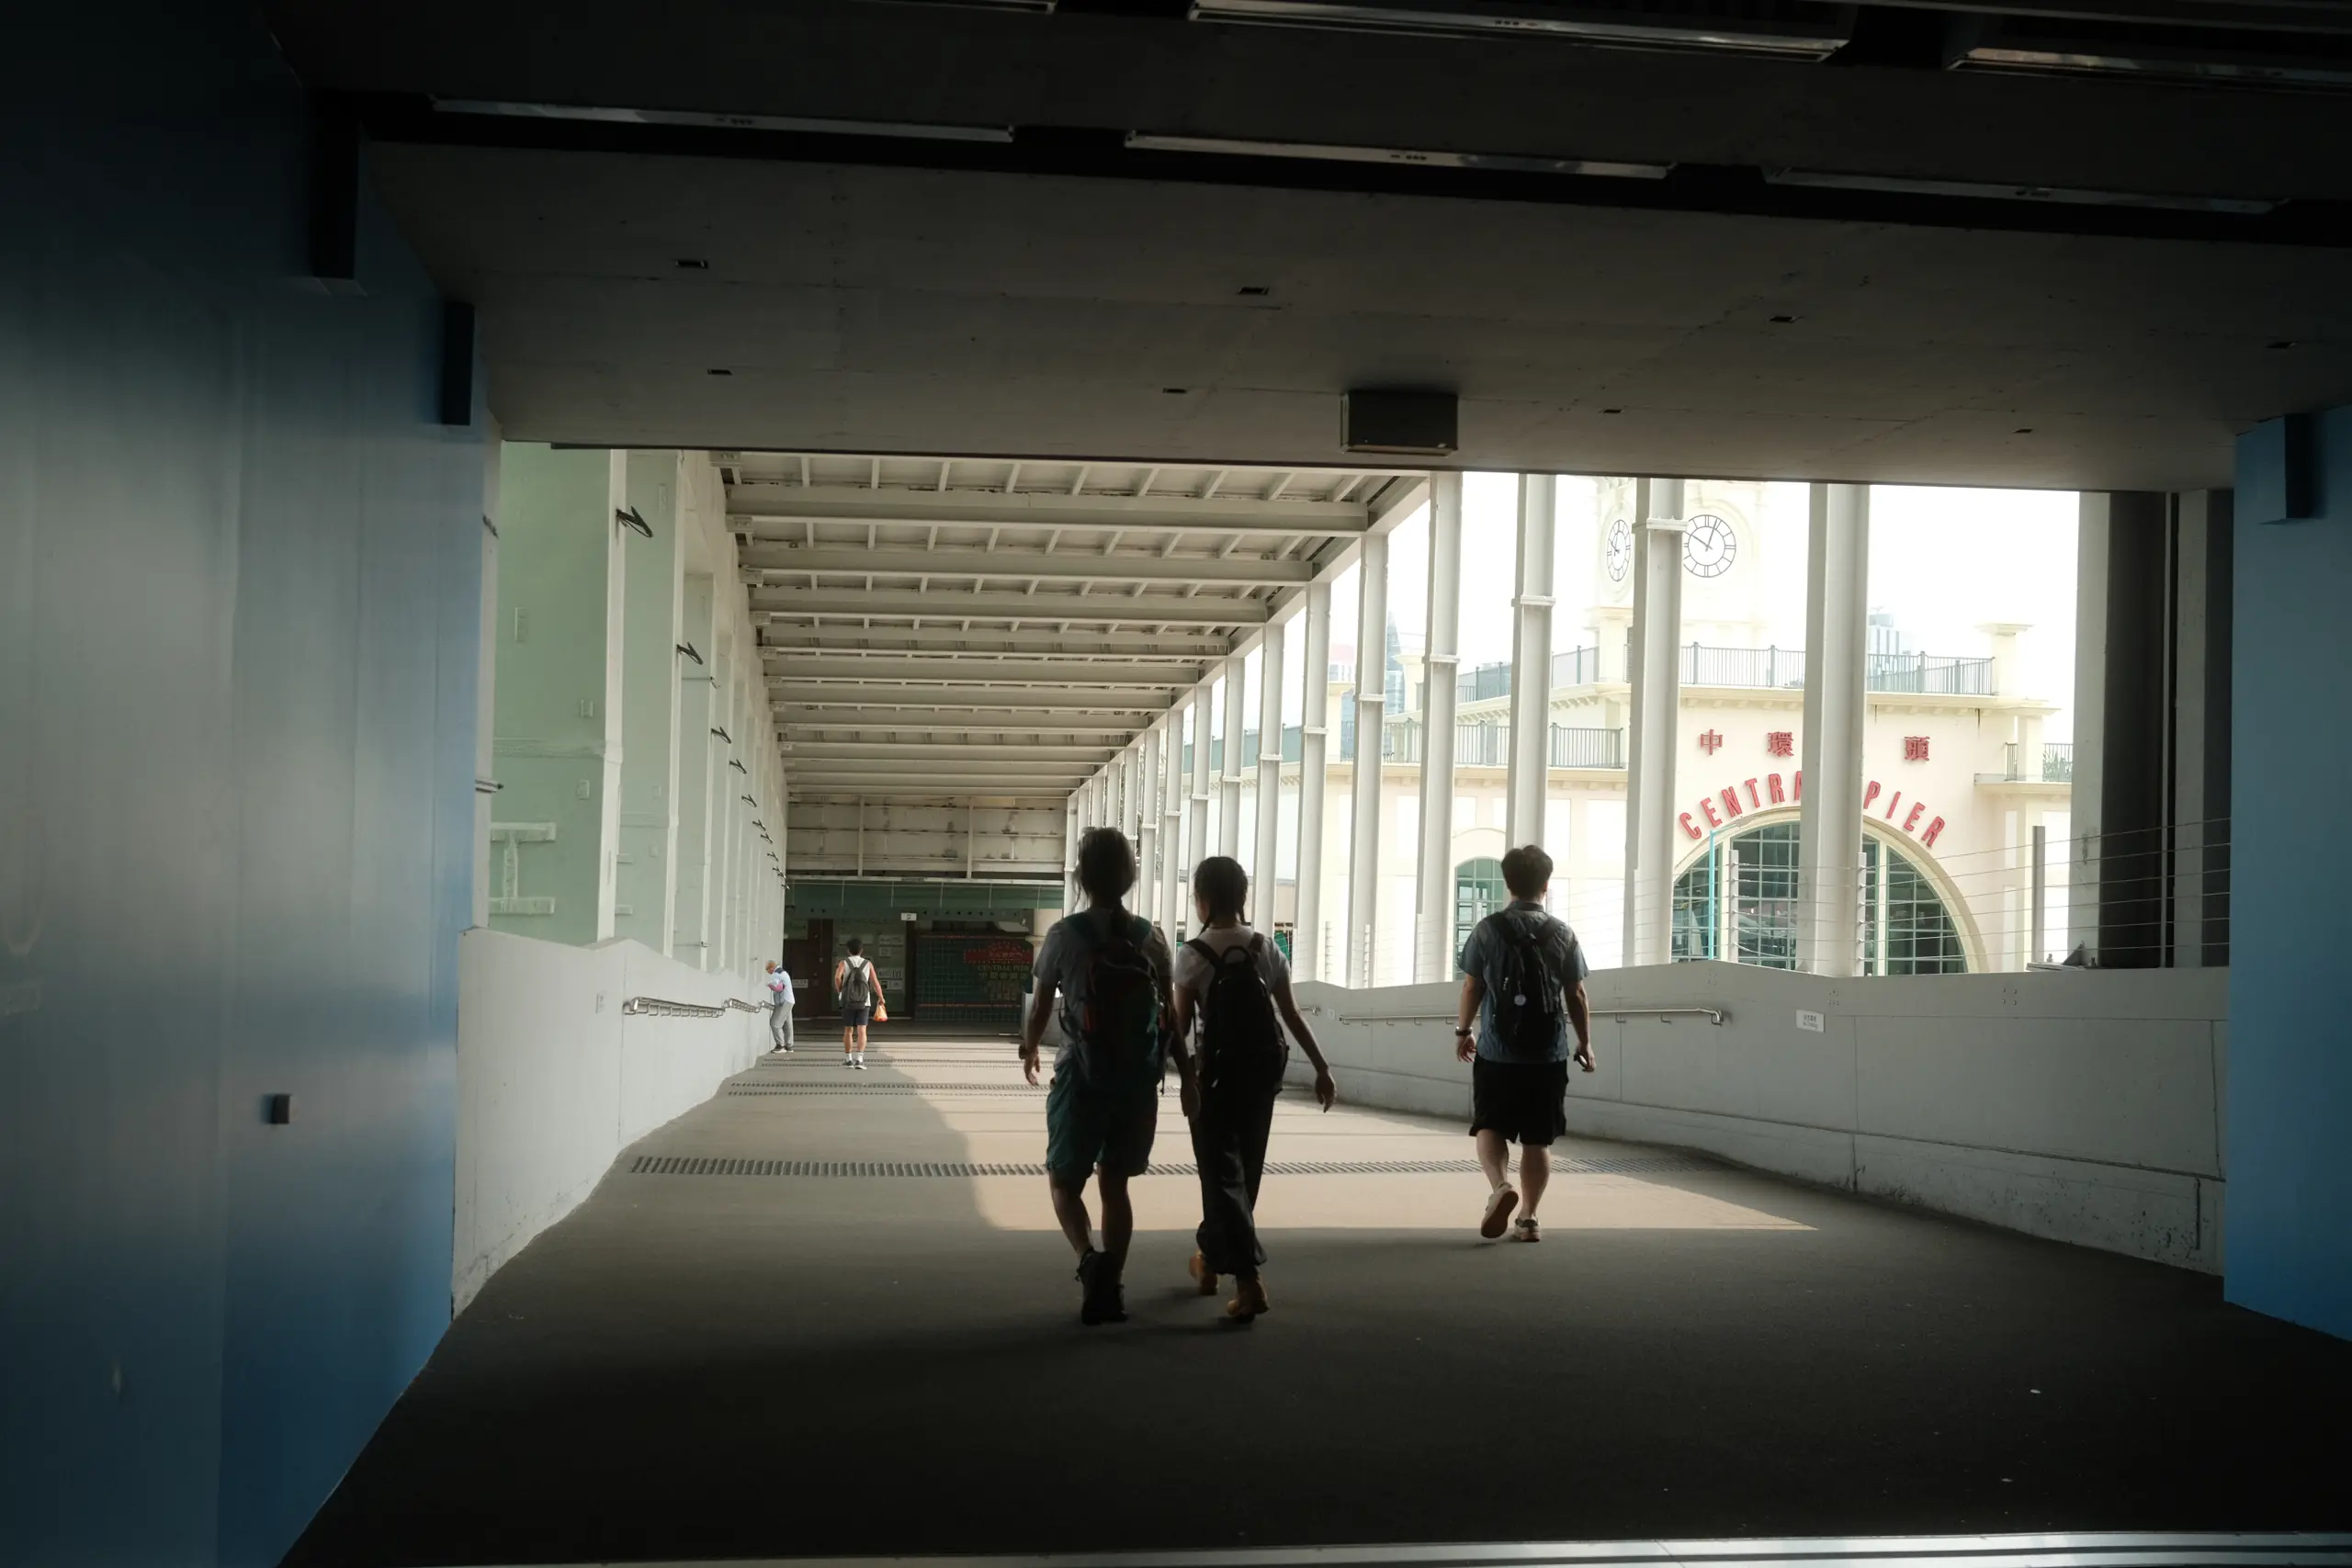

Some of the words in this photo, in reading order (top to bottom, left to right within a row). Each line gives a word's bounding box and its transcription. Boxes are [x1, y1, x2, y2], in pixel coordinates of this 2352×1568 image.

[1700, 729, 1929, 761] 中環頭
[1679, 770, 1802, 840] CENTR
[1862, 780, 1945, 849] PIER
